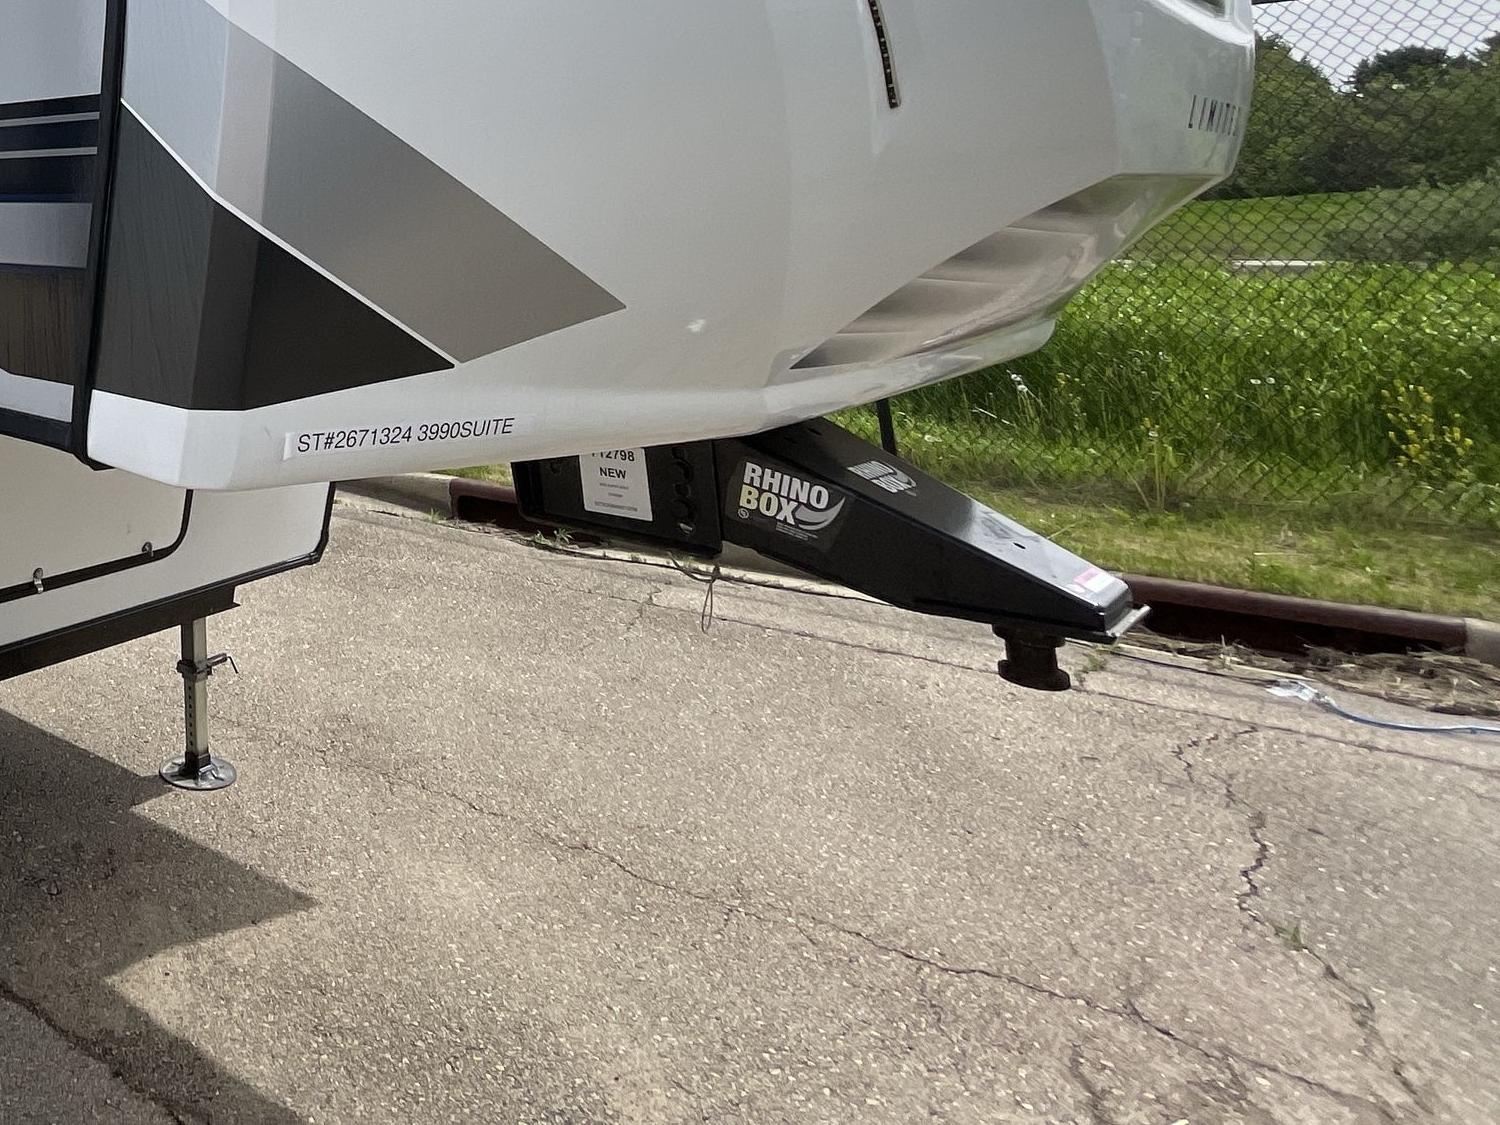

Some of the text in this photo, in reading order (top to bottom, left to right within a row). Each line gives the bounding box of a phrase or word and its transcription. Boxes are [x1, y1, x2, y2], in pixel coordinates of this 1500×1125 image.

[297, 418, 515, 453] ST#2671324 3990SUITE
[599, 466, 627, 480] NEW
[742, 461, 830, 510] RHINO
[870, 474, 913, 493] BOX
[739, 484, 799, 526] BOX
